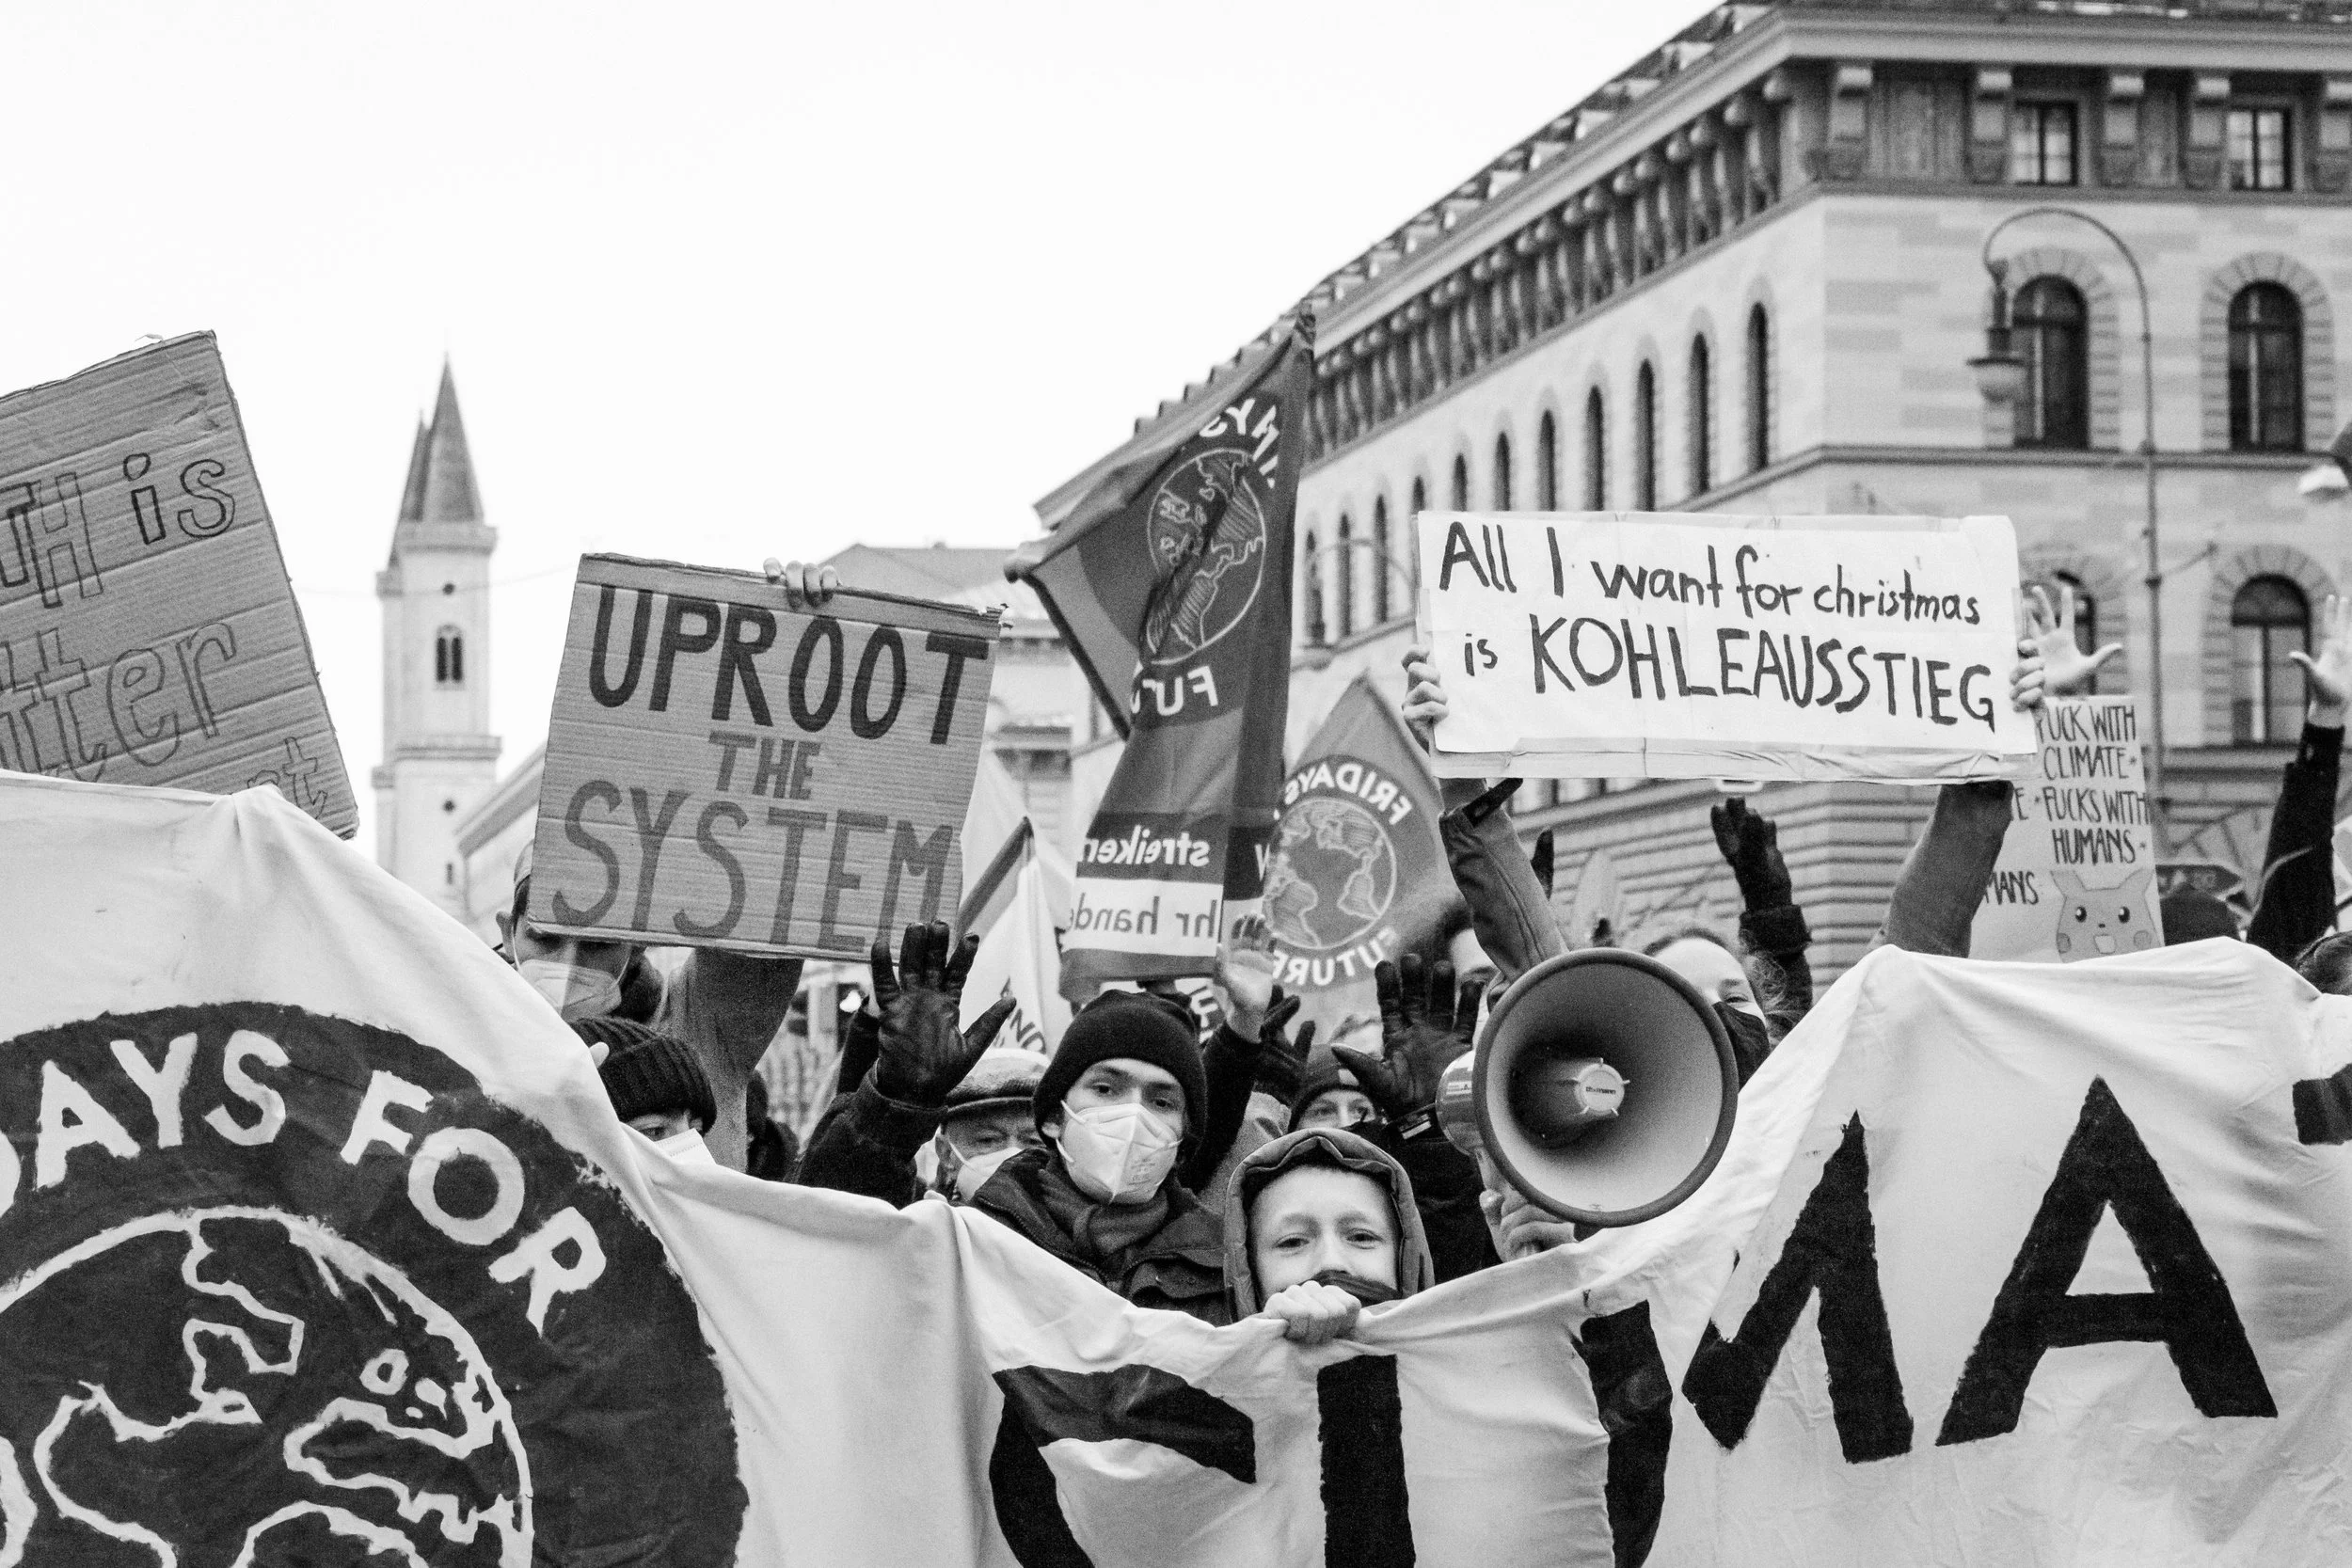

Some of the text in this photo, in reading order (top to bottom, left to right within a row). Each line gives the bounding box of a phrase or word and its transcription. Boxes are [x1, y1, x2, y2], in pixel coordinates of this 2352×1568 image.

[123, 452, 235, 545] is
[1438, 521, 1981, 625] All I want for christmas
[589, 583, 991, 746] UPROOT
[1462, 614, 1995, 732] is KOHLEAUSSTIEG
[709, 730, 822, 800] THE
[2043, 745, 2130, 781] CLIMATE
[2089, 705, 2137, 743] WITH
[2042, 786, 2102, 823] FUCKS
[2102, 788, 2151, 825] WITH
[2052, 827, 2136, 866] HUMANS
[551, 780, 954, 952] SYSTEM
[341, 1069, 607, 1337] FOR
